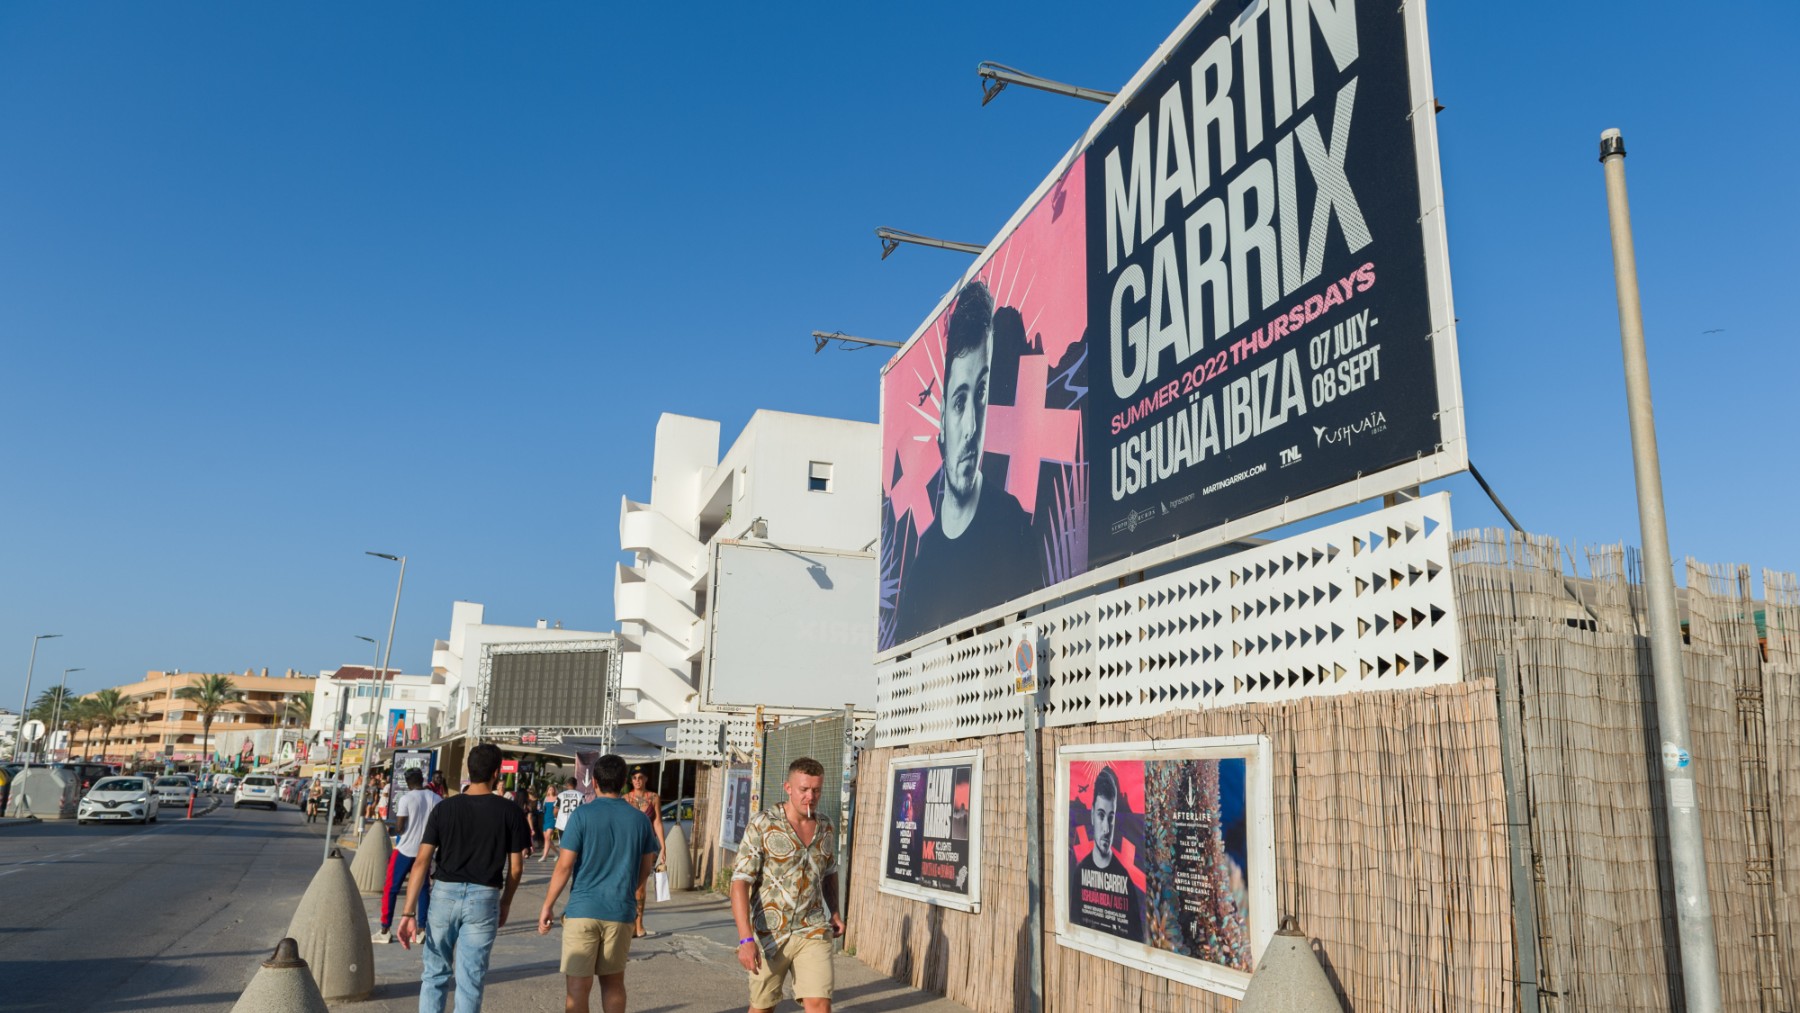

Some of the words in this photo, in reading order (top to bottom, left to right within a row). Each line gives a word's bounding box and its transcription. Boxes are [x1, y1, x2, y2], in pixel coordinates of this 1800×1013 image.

[1105, 0, 1359, 274] MARTIN
[1110, 75, 1374, 399] GARRIX
[1111, 379, 1180, 435] SUMMER
[1182, 351, 1229, 395] 2022
[1229, 262, 1376, 365] THURSDAYS
[1309, 328, 1331, 370] 07
[1311, 368, 1337, 408] 08
[1338, 345, 1381, 397] SEPT
[1112, 392, 1220, 501] USHUAÏA
[1222, 348, 1307, 450] IBIZA
[1279, 445, 1302, 465] TNL
[1202, 463, 1267, 495] MARTINGARRIX.COM
[563, 799, 578, 814] 23
[1172, 811, 1211, 822] AFTERLIFE
[922, 840, 935, 860] MK
[1081, 868, 1104, 890] MARTIN
[1104, 872, 1129, 895] GARRIX
